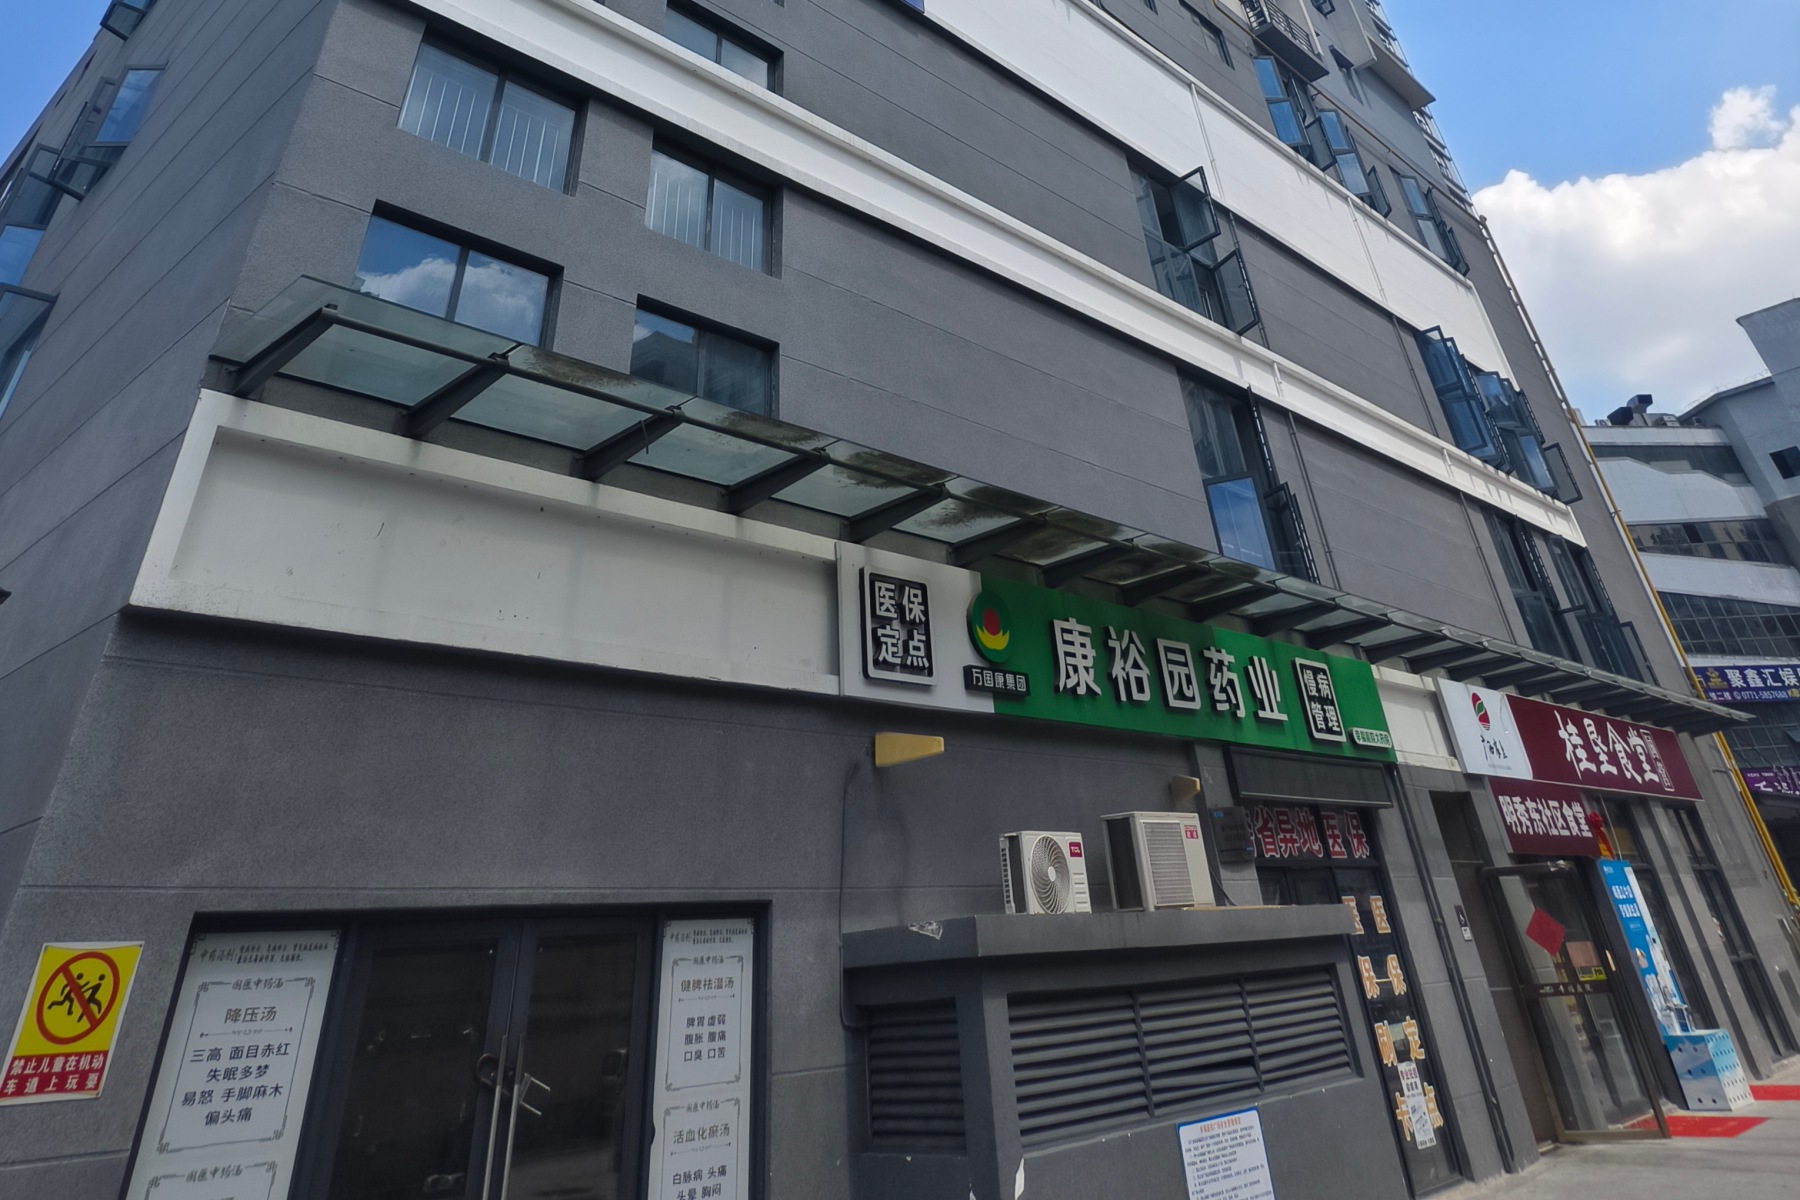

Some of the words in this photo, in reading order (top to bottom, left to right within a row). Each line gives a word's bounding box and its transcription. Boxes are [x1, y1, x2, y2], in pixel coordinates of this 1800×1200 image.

[874, 581, 926, 623] 医保
[877, 625, 929, 668] 定点
[971, 668, 1027, 692] 万国康集团
[1052, 617, 1288, 721] 康裕园药业
[1724, 667, 1800, 688] 聚鑫汇娱
[1303, 668, 1332, 700] 慢病
[1311, 701, 1340, 732] 管理
[1554, 710, 1660, 784] 桂垦食堂
[1498, 795, 1593, 837] 明秀东社区食堂
[681, 976, 734, 992] 健脾祛湿汤
[224, 1006, 278, 1024] 降压汤
[684, 1033, 703, 1045] 腹胀
[707, 1030, 727, 1043] 腹痛
[10, 1053, 105, 1076] 禁止儿童在机动
[190, 1047, 223, 1063] 三高
[228, 1043, 291, 1060] 面目赤红
[684, 1049, 702, 1062] 口臭
[707, 1047, 726, 1059] 口苦
[4, 1072, 99, 1095] 车道上玩耍
[206, 1064, 270, 1083] 失眠多梦
[181, 1089, 214, 1106] 易怒
[221, 1083, 283, 1103] 手脚麻木
[205, 1107, 253, 1126] 偏头痛
[707, 1165, 727, 1179] 头痛
